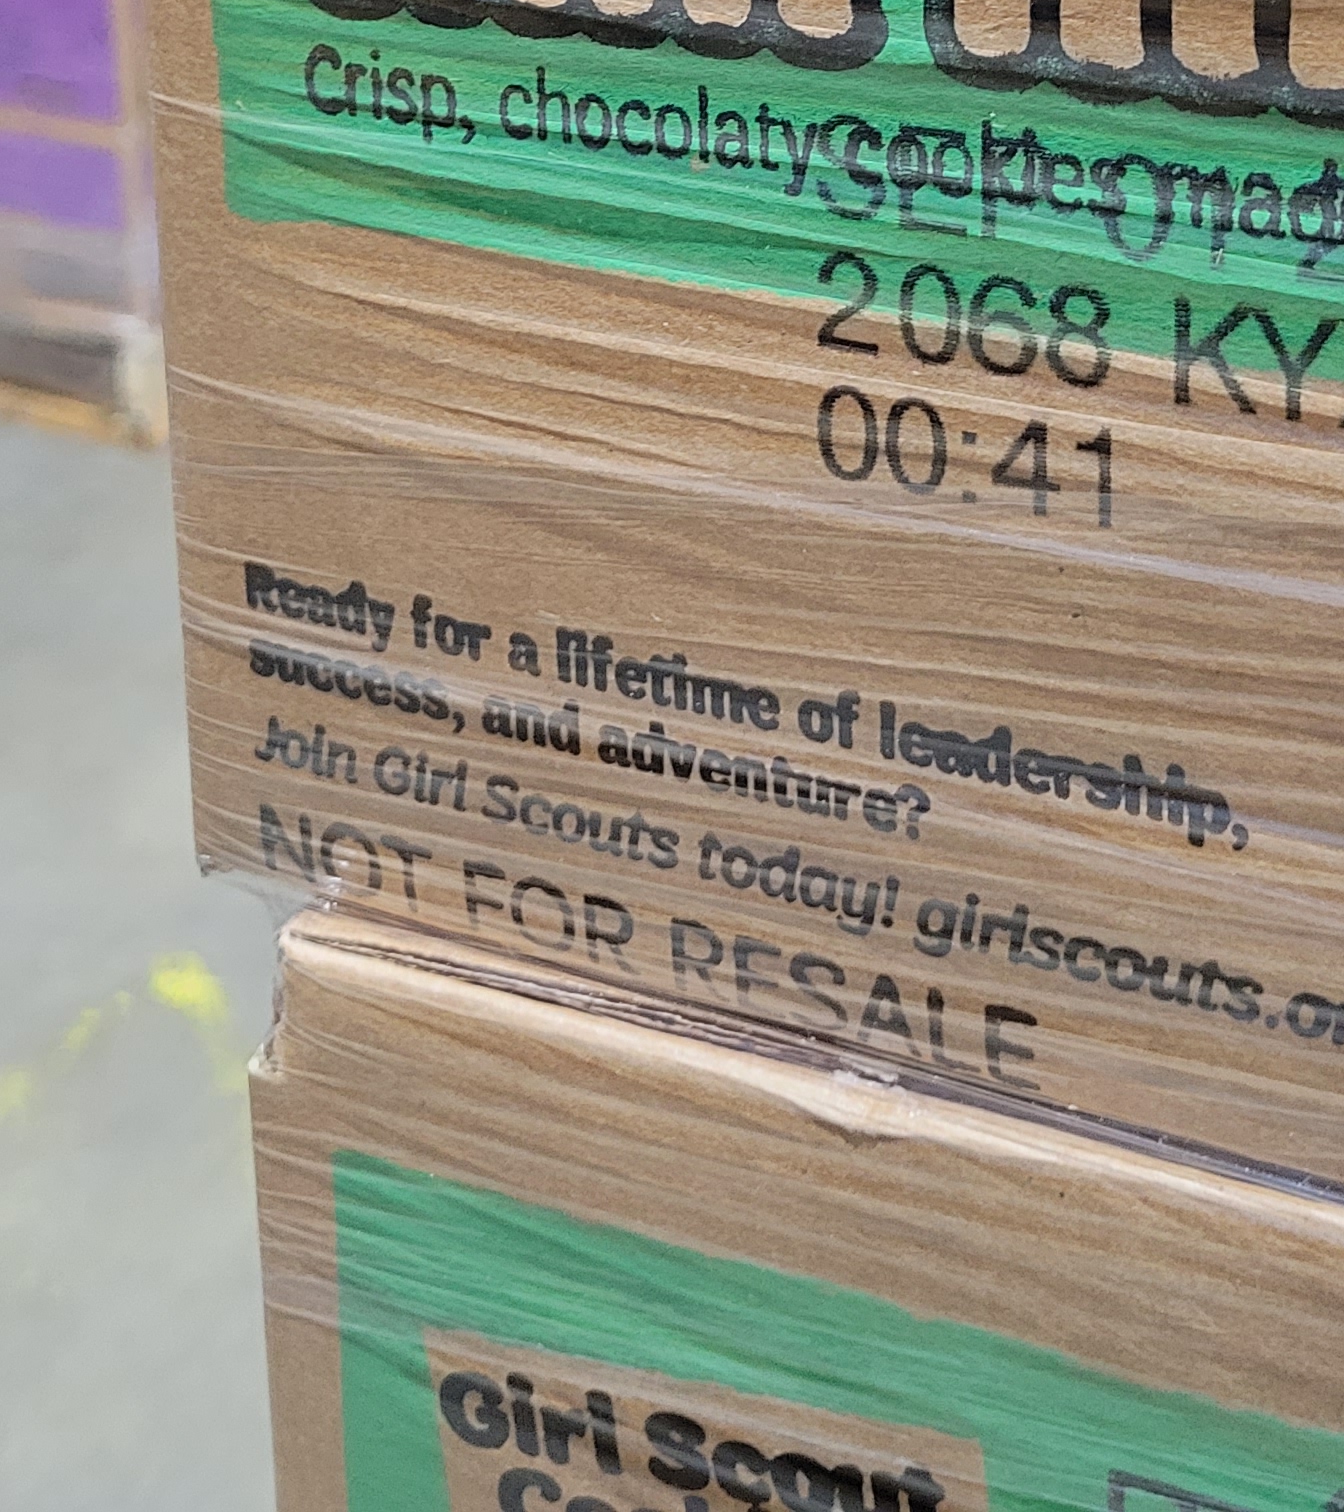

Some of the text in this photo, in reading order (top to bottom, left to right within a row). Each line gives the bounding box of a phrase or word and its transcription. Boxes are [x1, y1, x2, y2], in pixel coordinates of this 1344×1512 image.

[303, 42, 477, 144] Crisp,
[498, 65, 820, 198] chocolaty
[844, 119, 1128, 216] cookies
[815, 249, 1112, 389] 2068
[817, 384, 1113, 529] 00:41
[244, 560, 1250, 852] Ready for a lifetime of leadership,
[248, 637, 932, 841] success, and adventure?
[255, 715, 358, 785] Join
[373, 745, 468, 813] Girl
[481, 773, 680, 870] Scouts
[698, 831, 901, 937] today!
[260, 802, 1041, 1091] NOT FOR RESALE
[439, 1371, 624, 1476] Girl
